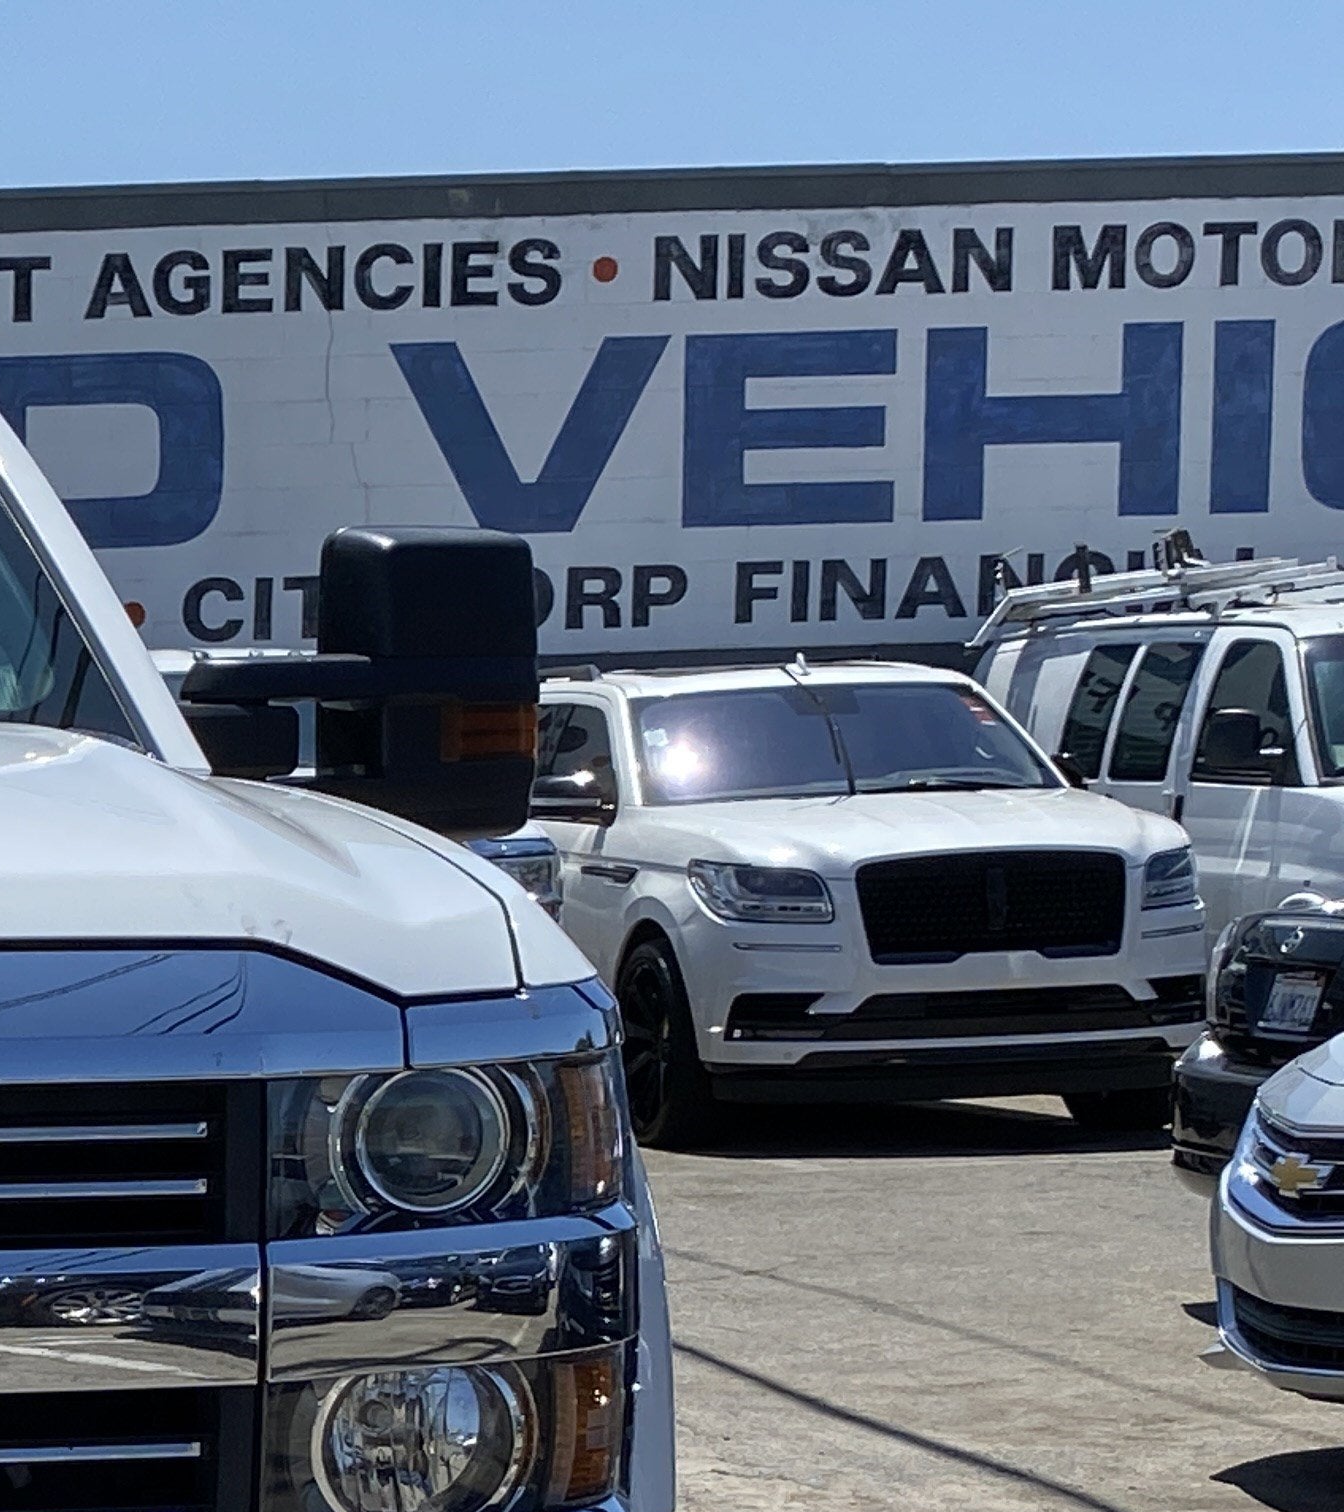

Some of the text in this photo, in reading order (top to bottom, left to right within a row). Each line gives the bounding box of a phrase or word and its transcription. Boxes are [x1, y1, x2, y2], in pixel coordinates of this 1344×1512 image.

[84, 239, 562, 320] AGENCIES
[652, 218, 1344, 300] NISSAN MOTO
[389, 319, 1344, 533] VEHI
